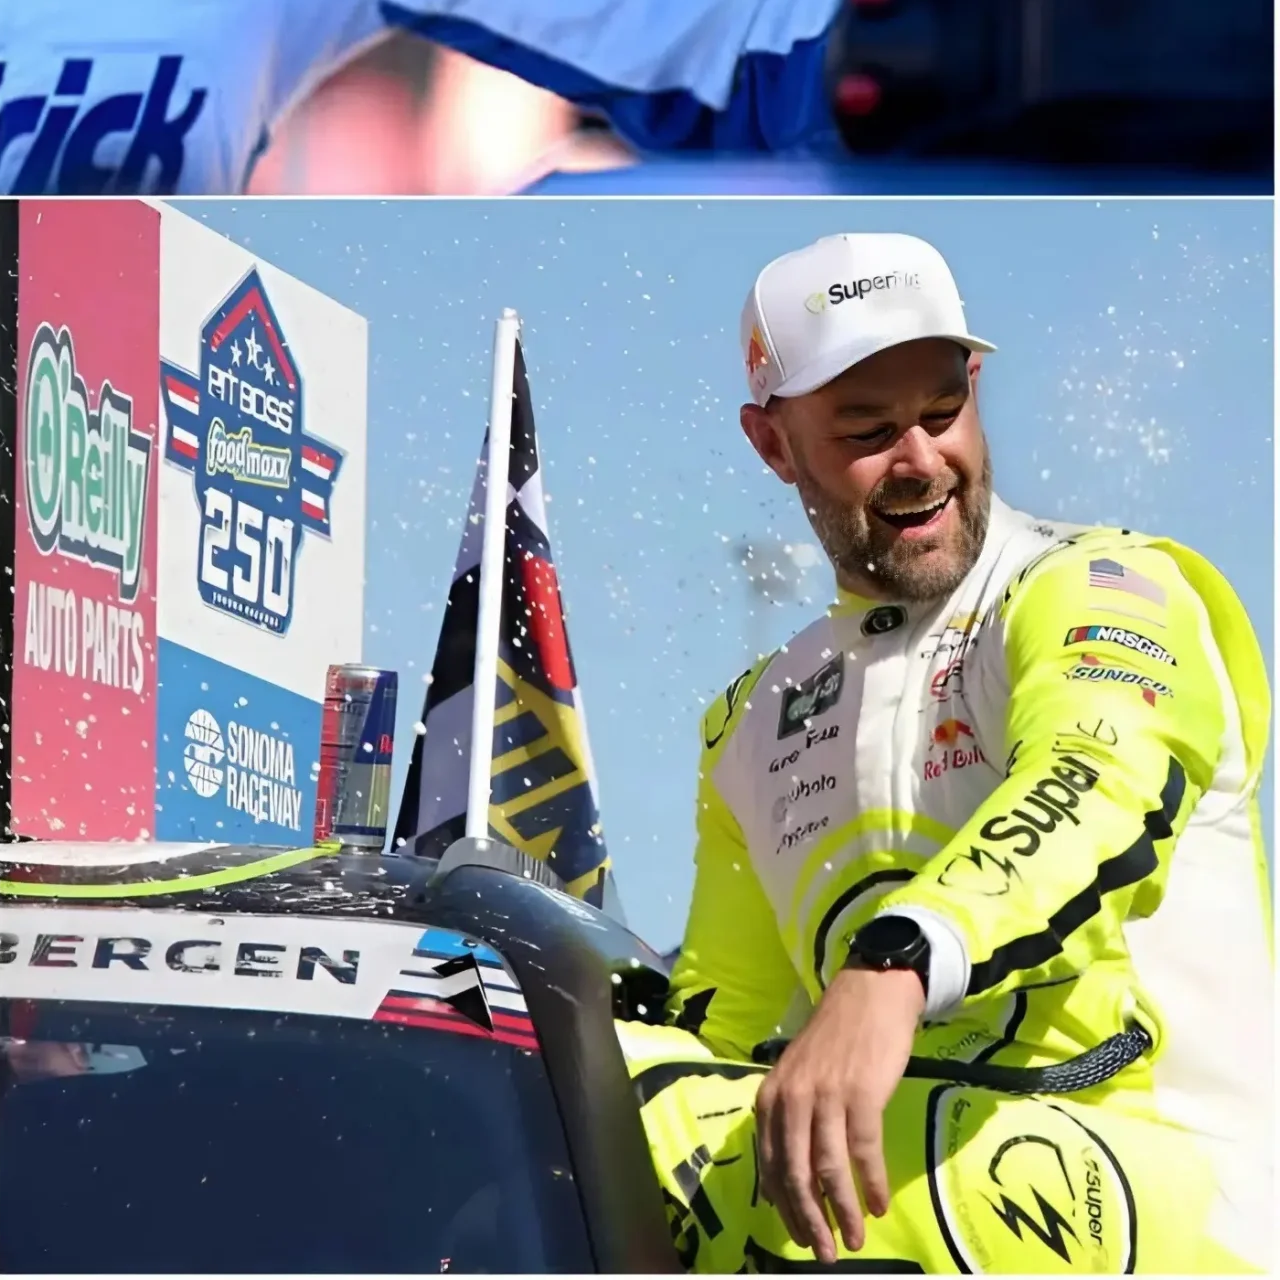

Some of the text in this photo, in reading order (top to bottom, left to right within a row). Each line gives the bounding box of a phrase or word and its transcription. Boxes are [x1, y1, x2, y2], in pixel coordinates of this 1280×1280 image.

[208, 364, 293, 435] PIT BOSS
[25, 340, 148, 580] O'Reilly
[208, 420, 288, 482] foodmaxx
[202, 487, 293, 618] 250
[24, 581, 144, 695] AUTO PARTS
[227, 721, 295, 787] SONOMA
[227, 765, 302, 831] RACEWAY
